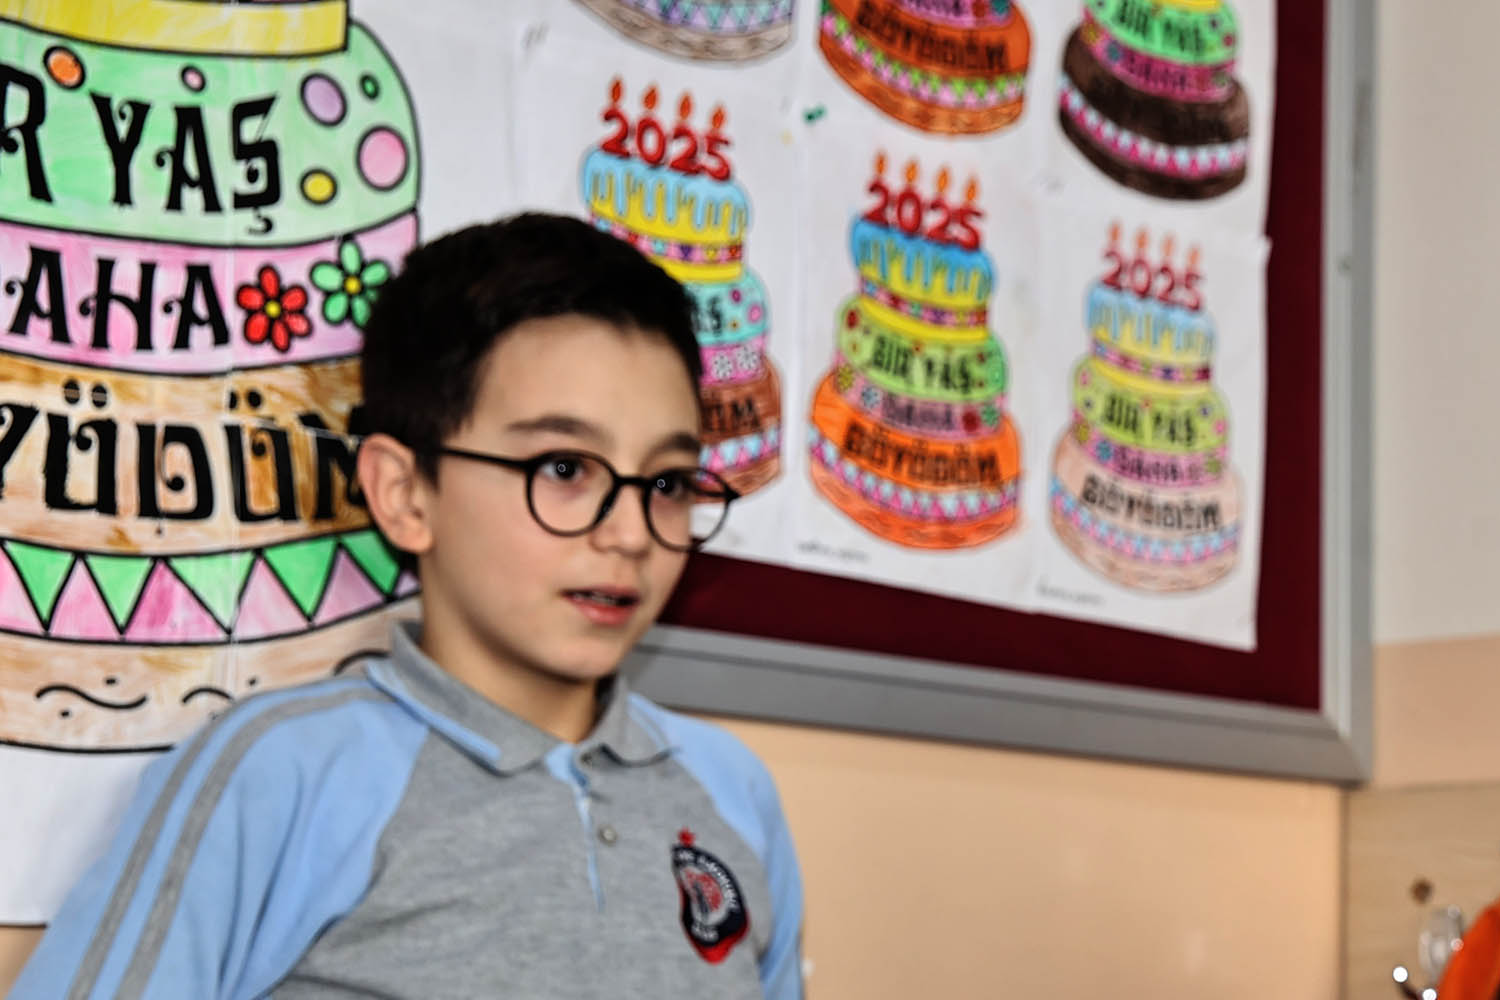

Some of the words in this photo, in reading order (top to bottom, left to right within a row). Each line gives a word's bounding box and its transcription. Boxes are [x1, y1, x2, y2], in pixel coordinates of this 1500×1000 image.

[90, 91, 281, 234] YAŞ
[601, 108, 732, 182] 2025
[861, 181, 983, 252] 2025
[5, 244, 230, 350] AHA
[1101, 251, 1203, 312] 2025
